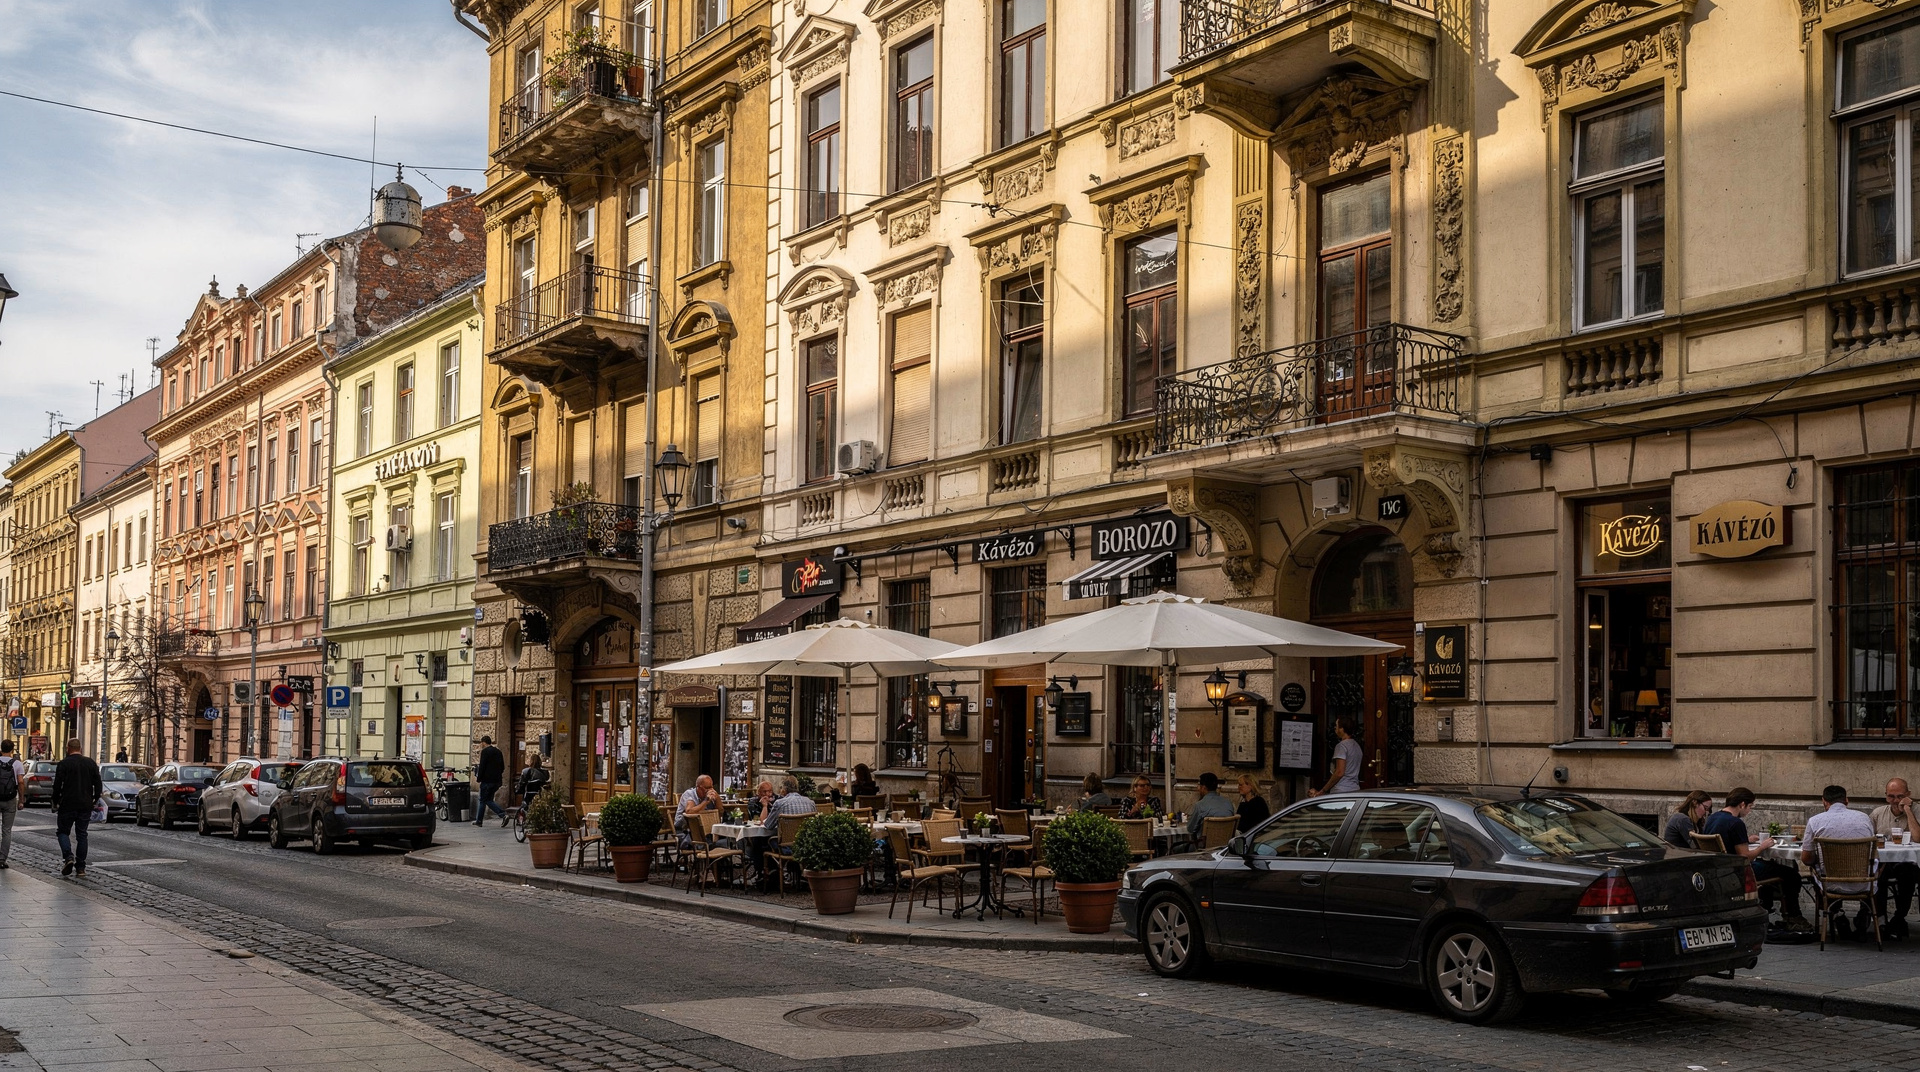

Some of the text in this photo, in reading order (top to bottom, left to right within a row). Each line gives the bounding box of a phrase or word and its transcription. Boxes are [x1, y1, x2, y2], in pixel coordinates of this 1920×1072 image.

[1098, 519, 1177, 555] BOROZO
[1696, 511, 1776, 545] KÁVÉZÓ
[977, 535, 1035, 561] Kávézó
[332, 688, 345, 705] P
